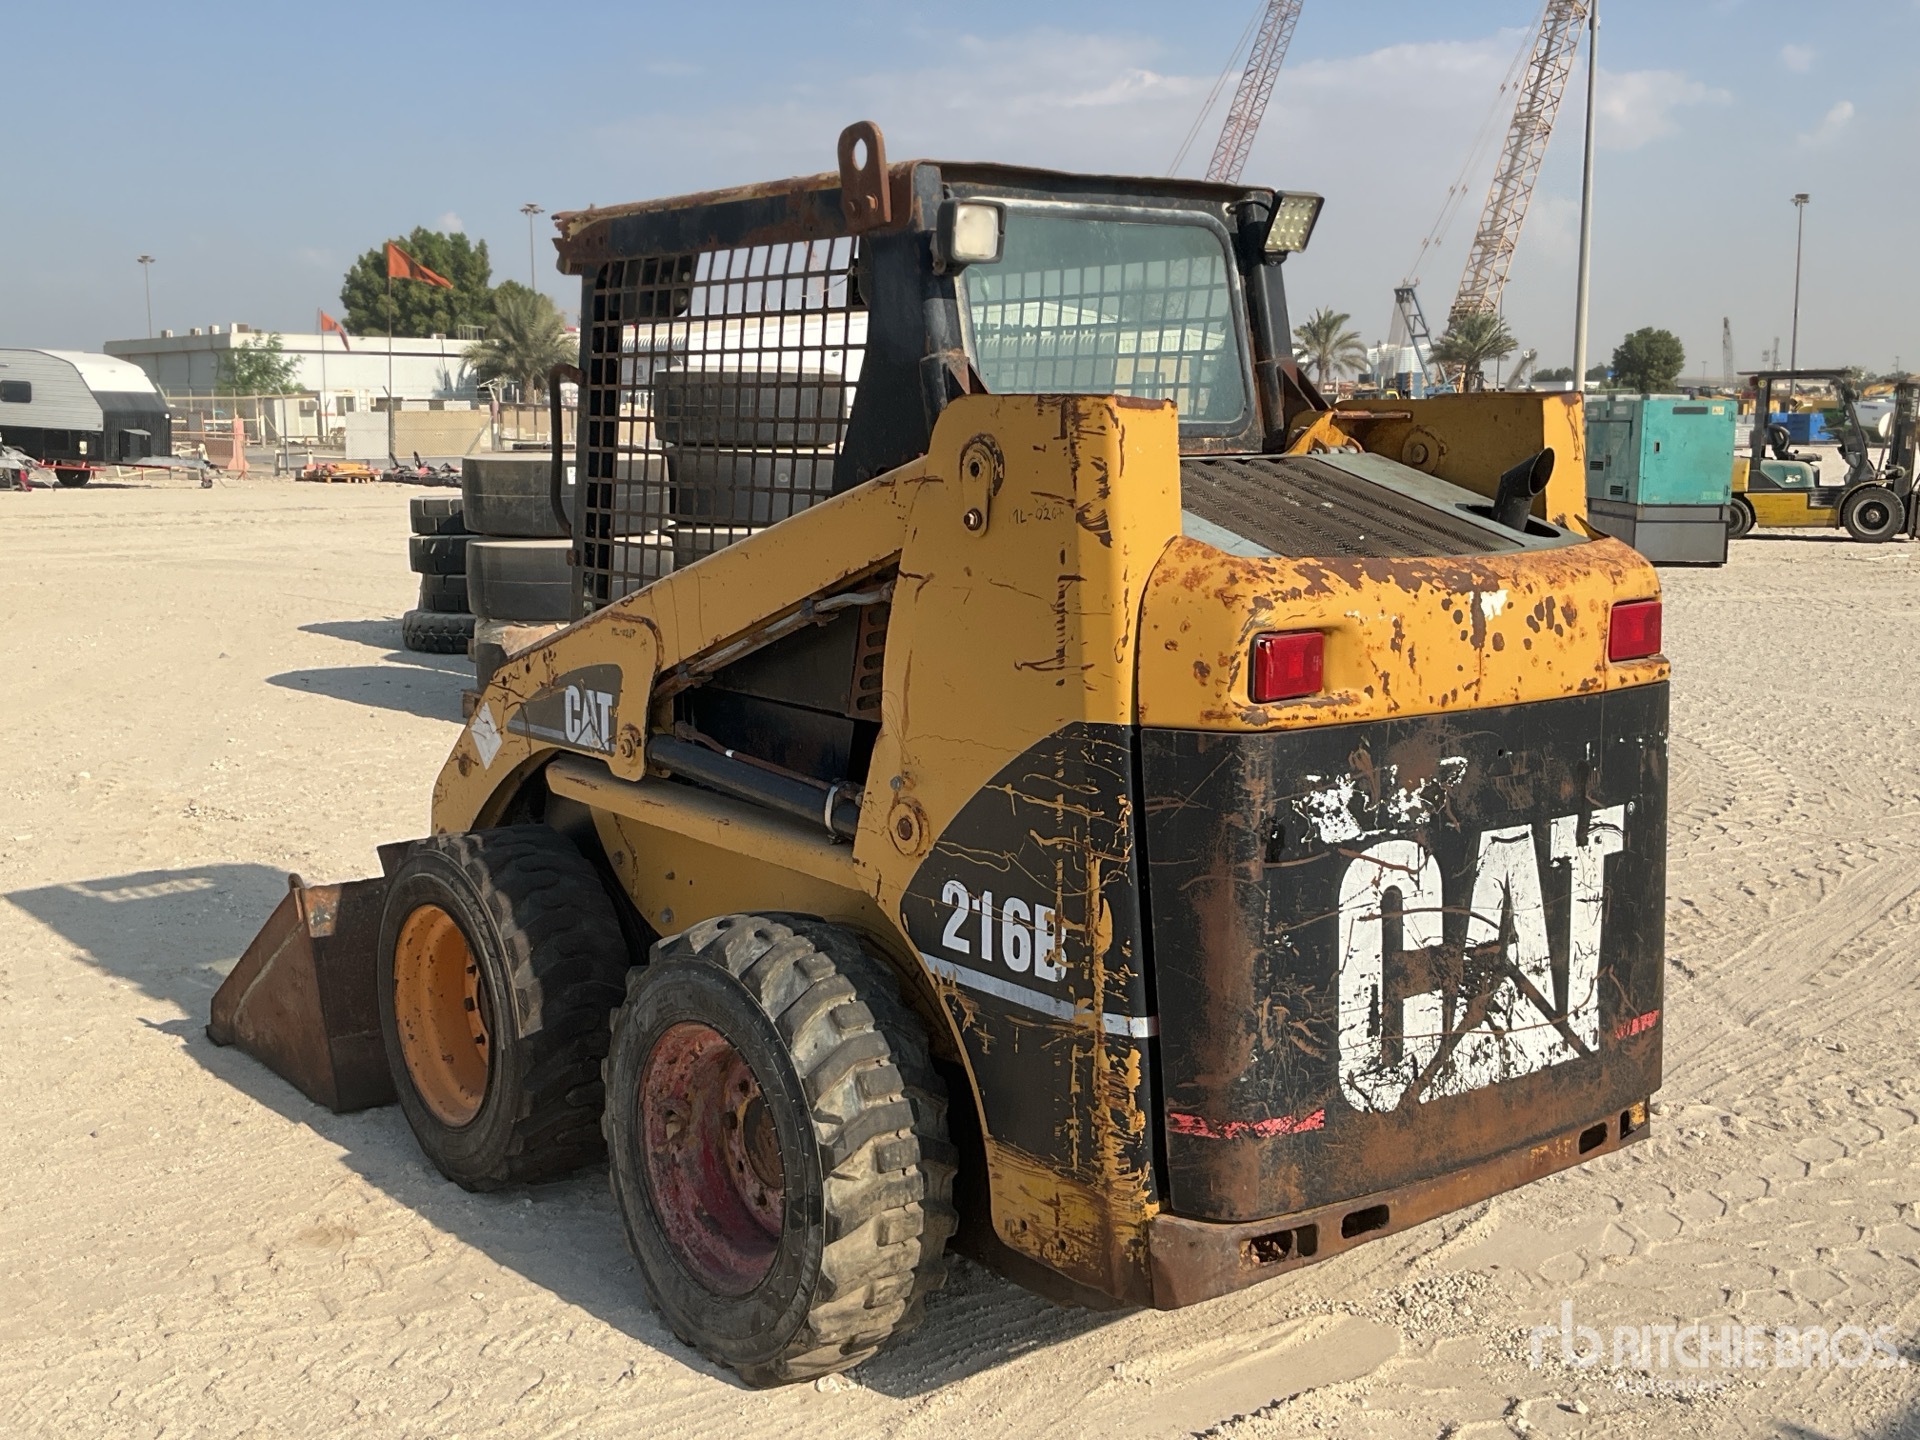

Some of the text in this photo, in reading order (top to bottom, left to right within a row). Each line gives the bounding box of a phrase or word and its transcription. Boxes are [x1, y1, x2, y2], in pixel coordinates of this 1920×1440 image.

[565, 685, 613, 751] CAT
[941, 880, 1067, 983] 216B
[1338, 804, 1625, 1113] CAT
